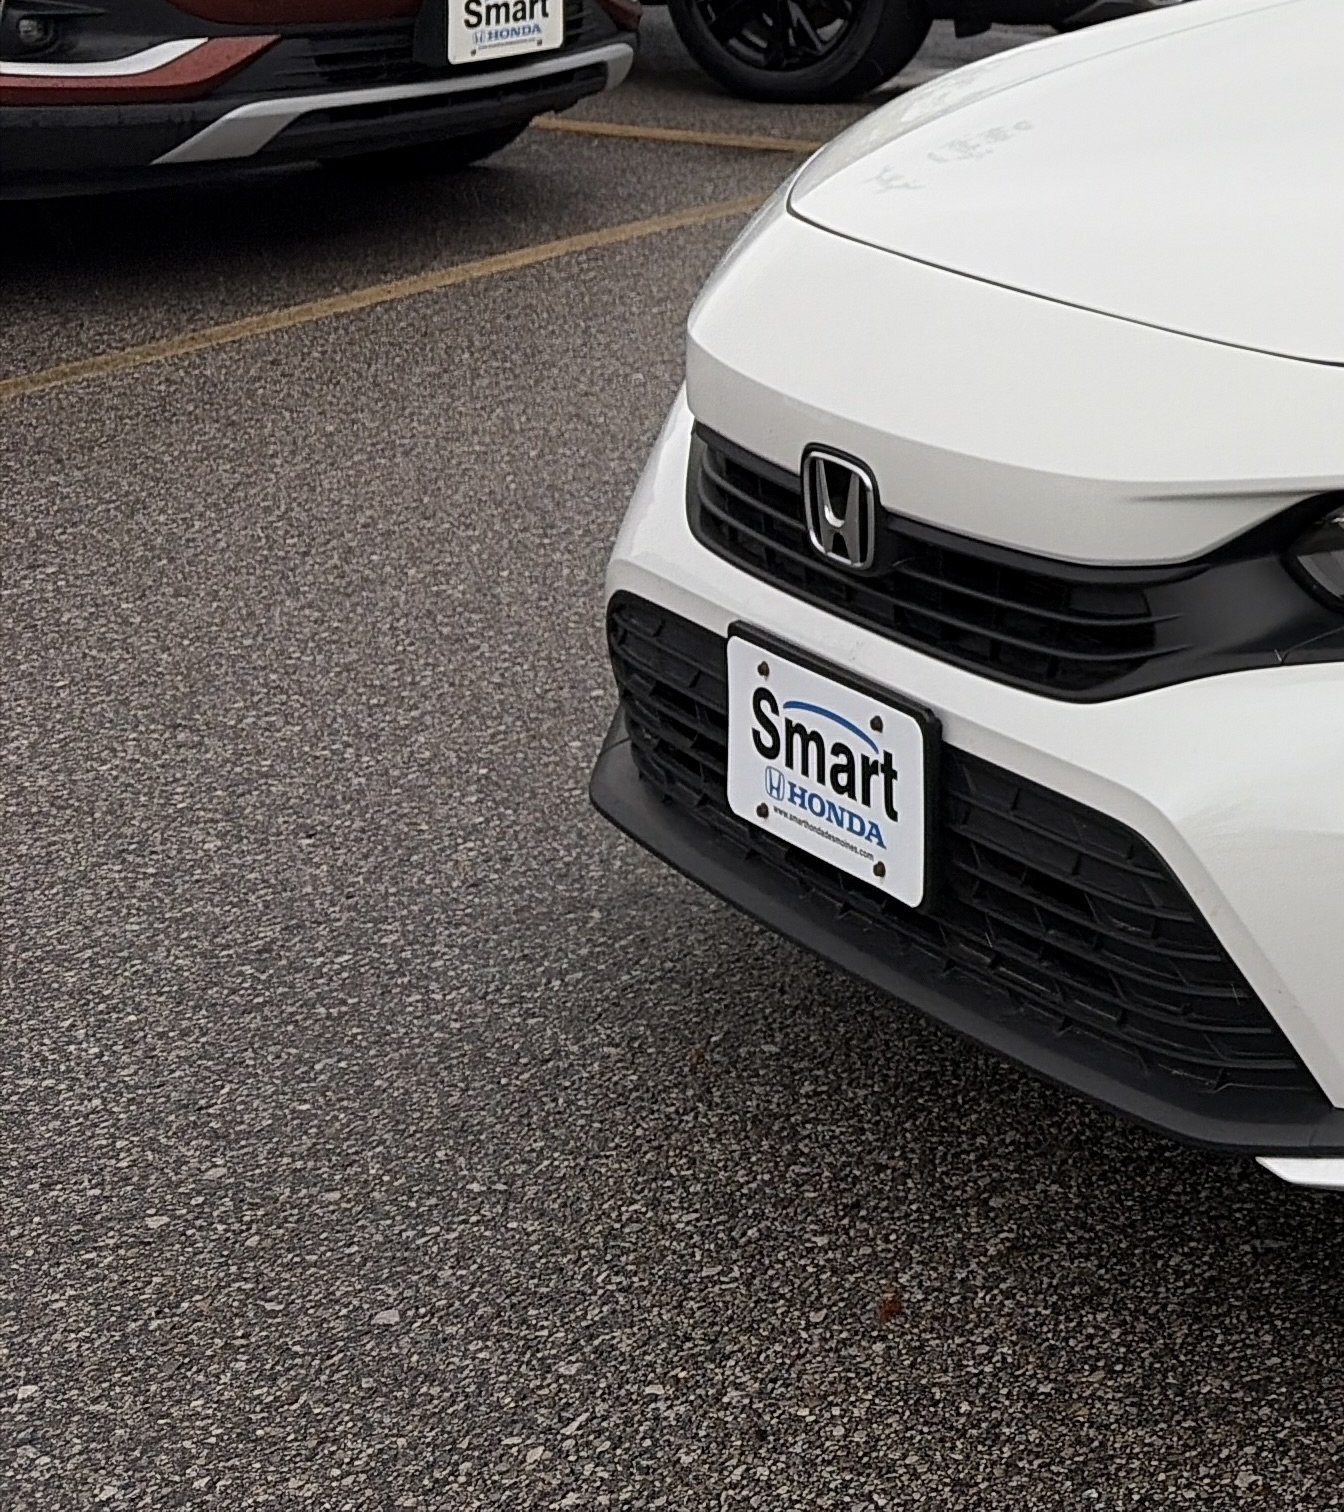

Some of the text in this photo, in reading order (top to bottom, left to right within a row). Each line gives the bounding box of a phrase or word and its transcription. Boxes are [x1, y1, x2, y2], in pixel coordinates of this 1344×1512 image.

[487, 24, 541, 41] HONDA
[752, 687, 898, 822] Smart
[787, 781, 887, 850] HONDA
